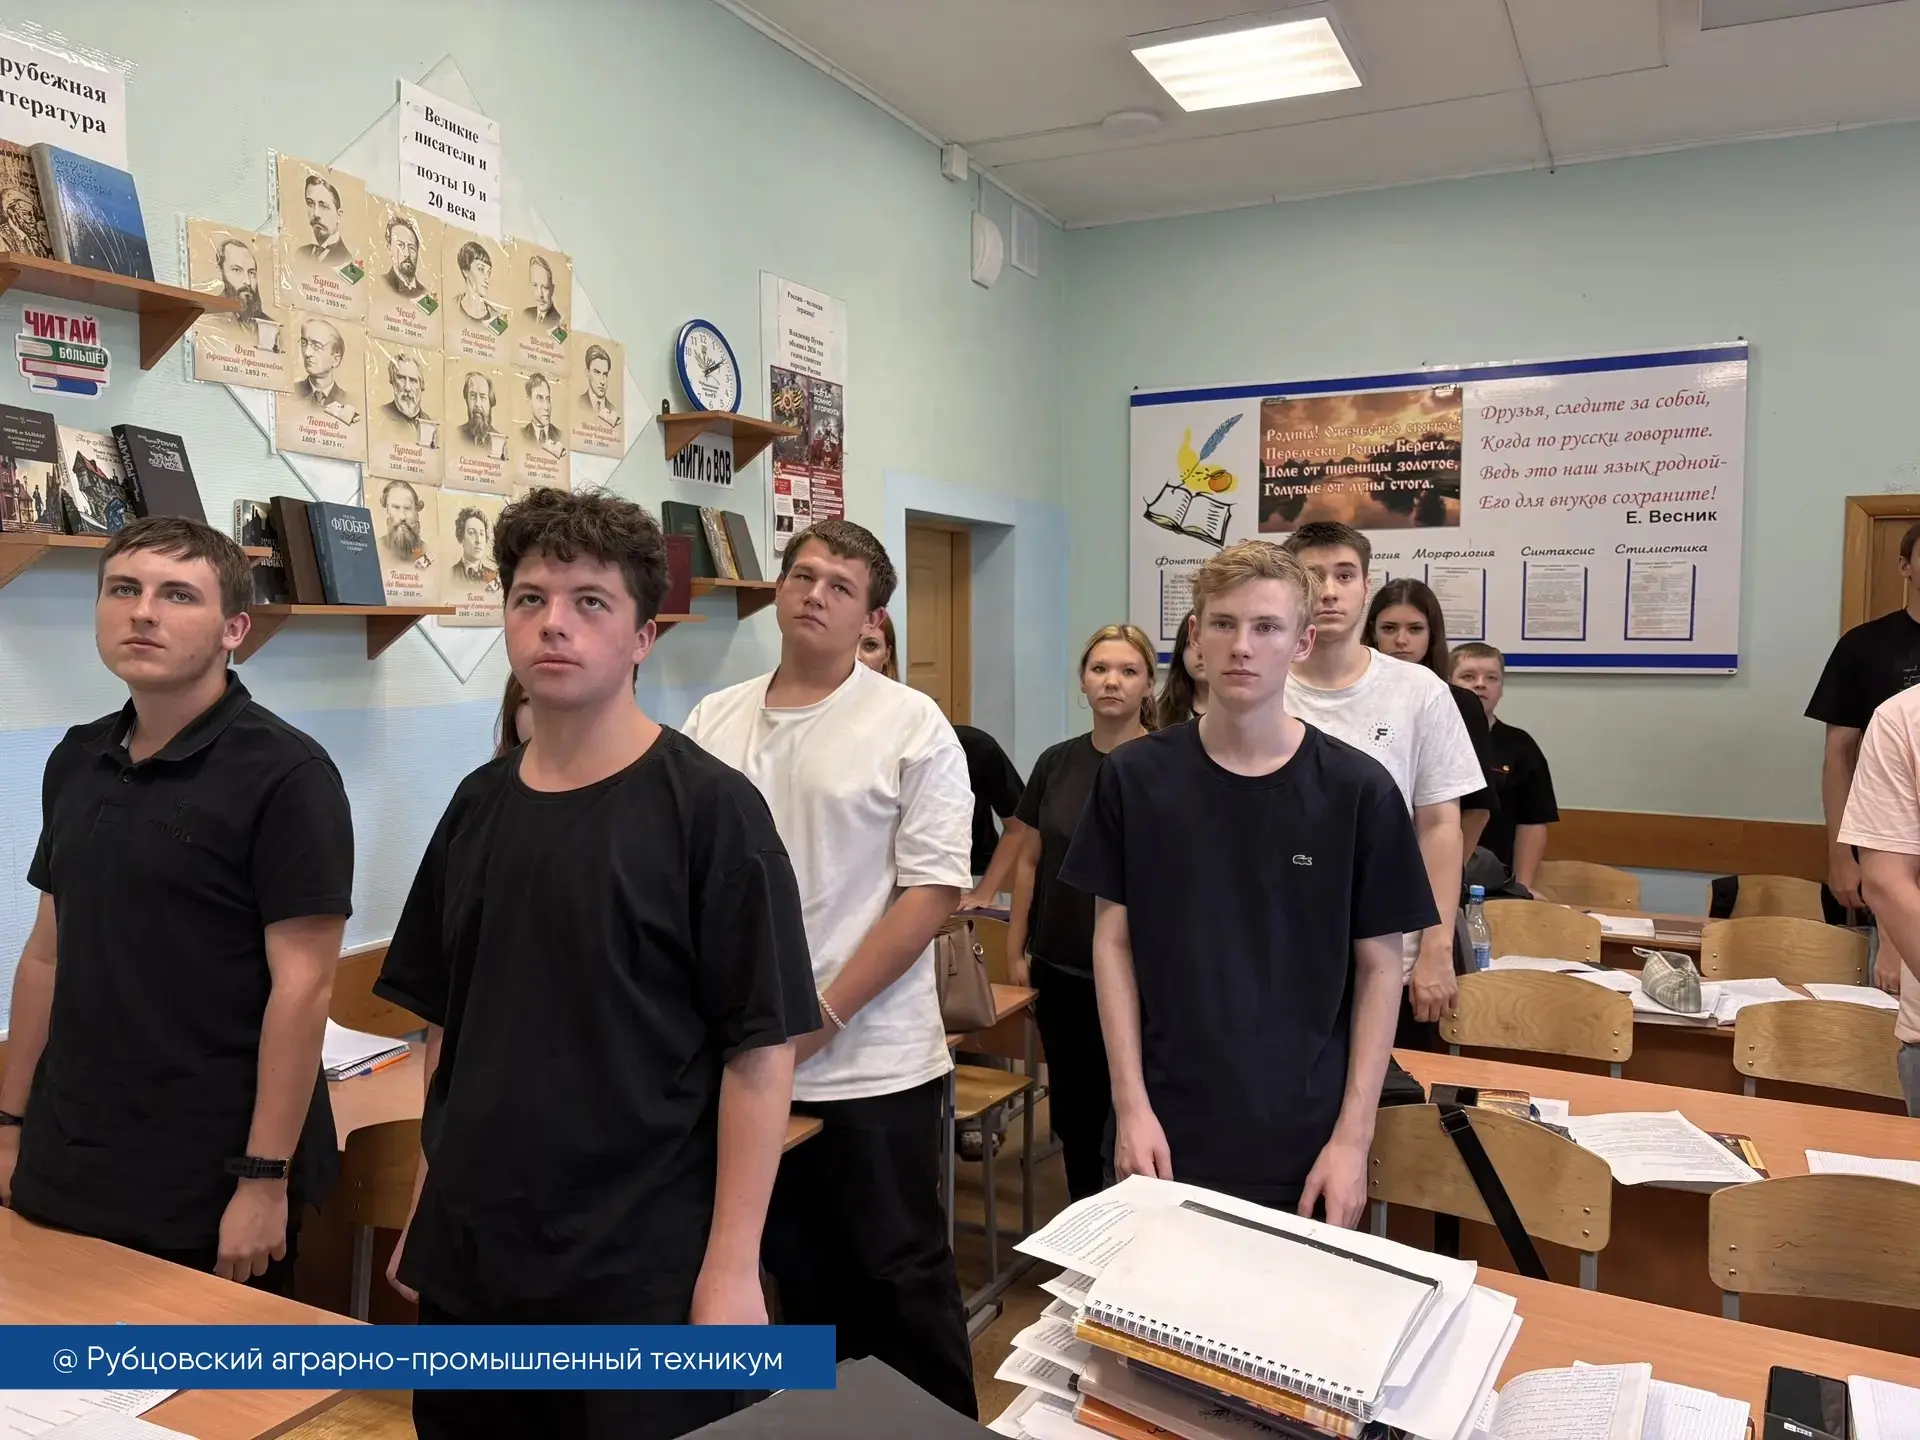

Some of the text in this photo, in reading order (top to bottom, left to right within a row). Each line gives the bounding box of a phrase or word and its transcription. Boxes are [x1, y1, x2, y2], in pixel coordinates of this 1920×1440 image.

[0, 57, 106, 103] рубежная
[425, 105, 479, 144] Великие
[414, 130, 487, 171] писатели и
[416, 165, 487, 202] поэты 19 и
[428, 190, 476, 222] 20 века
[312, 275, 340, 290] Бунин
[305, 294, 320, 302] 1870
[326, 298, 340, 307] 1953
[787, 291, 802, 303] Россия
[396, 306, 416, 320] Чехов
[24, 310, 97, 345] ЧИТАЙ
[691, 335, 697, 346] 11
[700, 334, 707, 344] 12
[811, 336, 824, 346] Путин
[59, 347, 105, 365] БОЛЬШЕ!
[234, 344, 256, 358] Фет
[685, 346, 692, 356] 10
[222, 364, 238, 373] 1820
[245, 368, 260, 377] 1892
[1481, 389, 1711, 424] Друзья, следите за собой,
[306, 415, 340, 430] Тютчев
[302, 436, 316, 444] 1803
[322, 439, 336, 447] 1873
[1266, 425, 1319, 443] Родина!
[1480, 424, 1713, 452] Когда по русски говорите.
[115, 433, 135, 478] РЕМАРК
[392, 443, 423, 457] Тургенев
[1265, 439, 1449, 462] Перелески. Рощи. Берега.
[673, 444, 731, 485] КНИГИ о ВОВ
[1264, 459, 1459, 479] Поле от пшеницы золотое,
[1479, 462, 1519, 480] Ведь
[1524, 463, 1557, 479] это
[1562, 461, 1599, 476] наш
[1603, 457, 1656, 475] язык
[1263, 479, 1434, 500] Голубые от луны стога.
[1479, 485, 1718, 511] Его для внуков сохраните!
[1625, 509, 1718, 524] Е. Весник
[331, 517, 370, 534] ФЛОБЕР
[1411, 548, 1496, 560] Морфология
[1520, 545, 1595, 558] Синтаксис
[1614, 543, 1708, 555] Стилистика
[390, 570, 419, 581] Толстой
[467, 593, 484, 602] Блок
